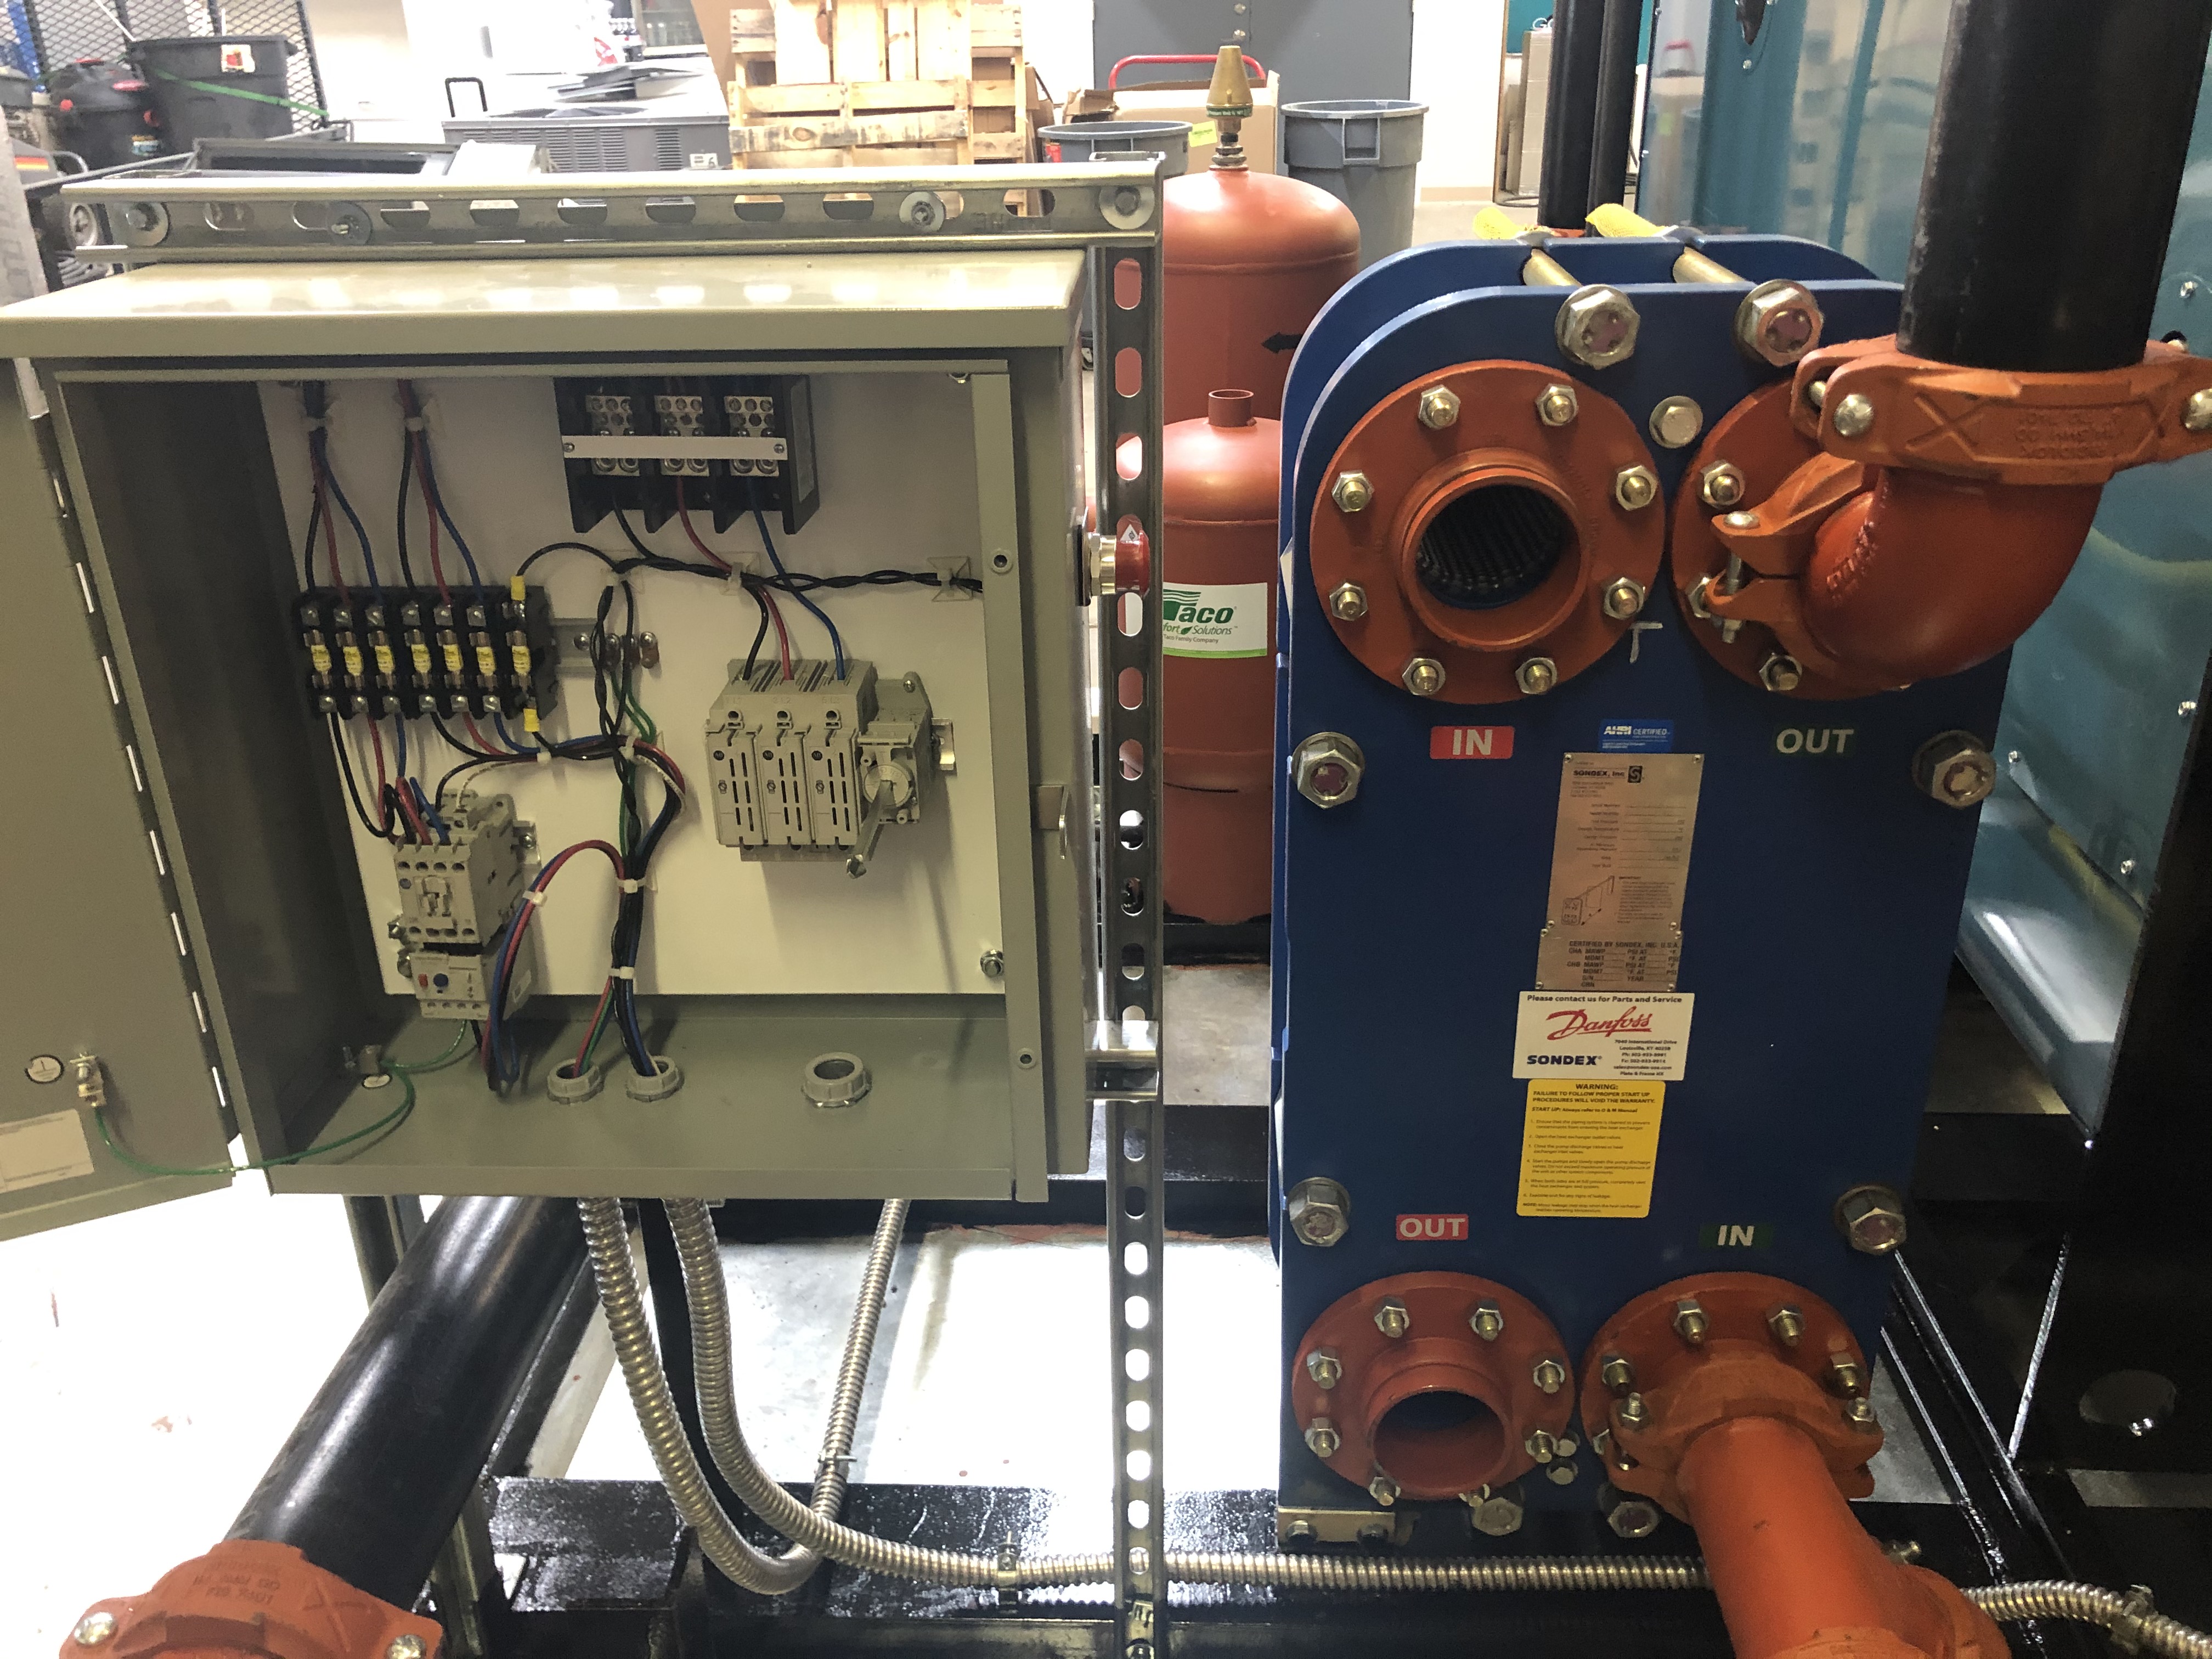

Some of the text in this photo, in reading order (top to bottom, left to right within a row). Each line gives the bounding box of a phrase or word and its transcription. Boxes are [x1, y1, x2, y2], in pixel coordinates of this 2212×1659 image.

[1163, 589, 1234, 624] Taco
[1163, 622, 1232, 635] fort Solutions
[1604, 725, 1632, 735] AHRI
[1776, 728, 1854, 754] OUT
[1452, 729, 1493, 756] IN
[1546, 1005, 1653, 1040] Danfoss
[1400, 1218, 1466, 1238] OUT
[1718, 1224, 1754, 1246] IN
